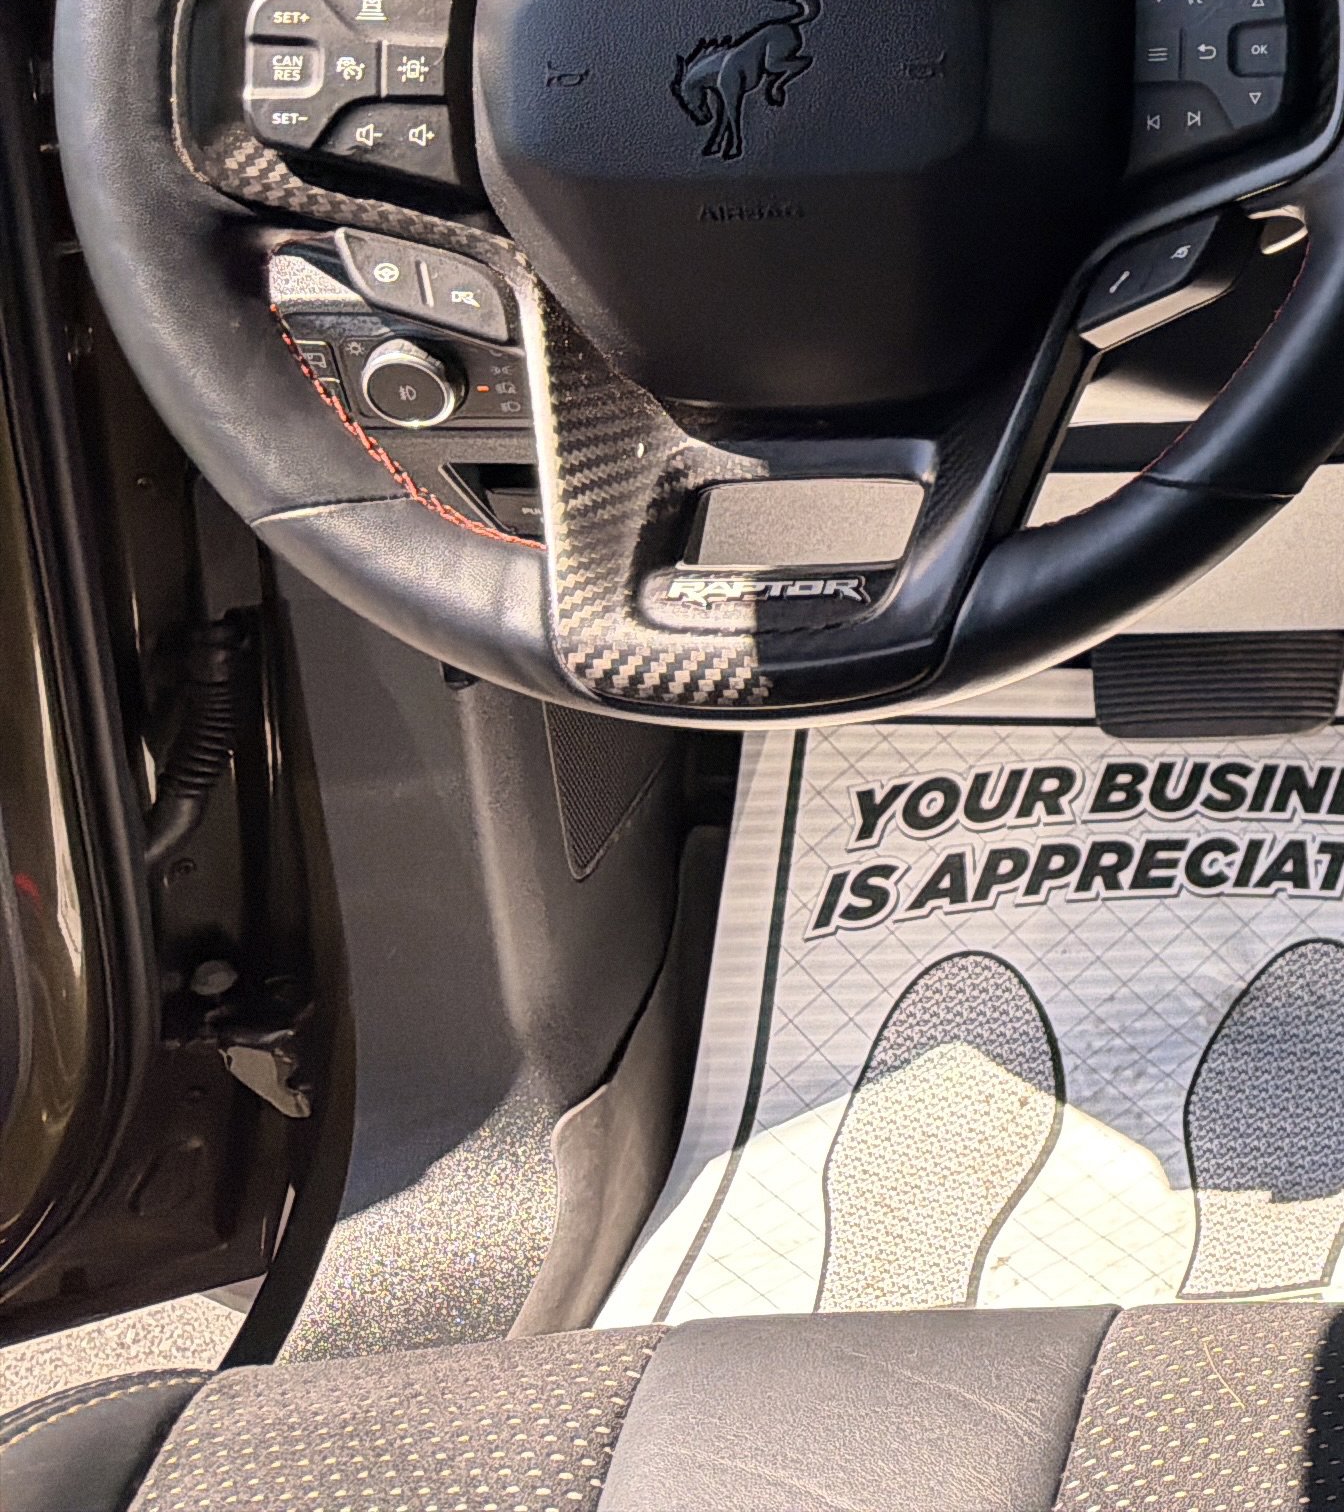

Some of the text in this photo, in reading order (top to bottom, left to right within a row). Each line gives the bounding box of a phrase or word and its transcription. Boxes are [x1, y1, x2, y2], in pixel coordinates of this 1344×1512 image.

[1250, 44, 1268, 55] OK
[273, 55, 302, 66] CAN
[274, 70, 301, 81] RES
[666, 576, 870, 606] RAPTOR
[854, 766, 1074, 842] YOUR
[811, 864, 895, 931] IS
